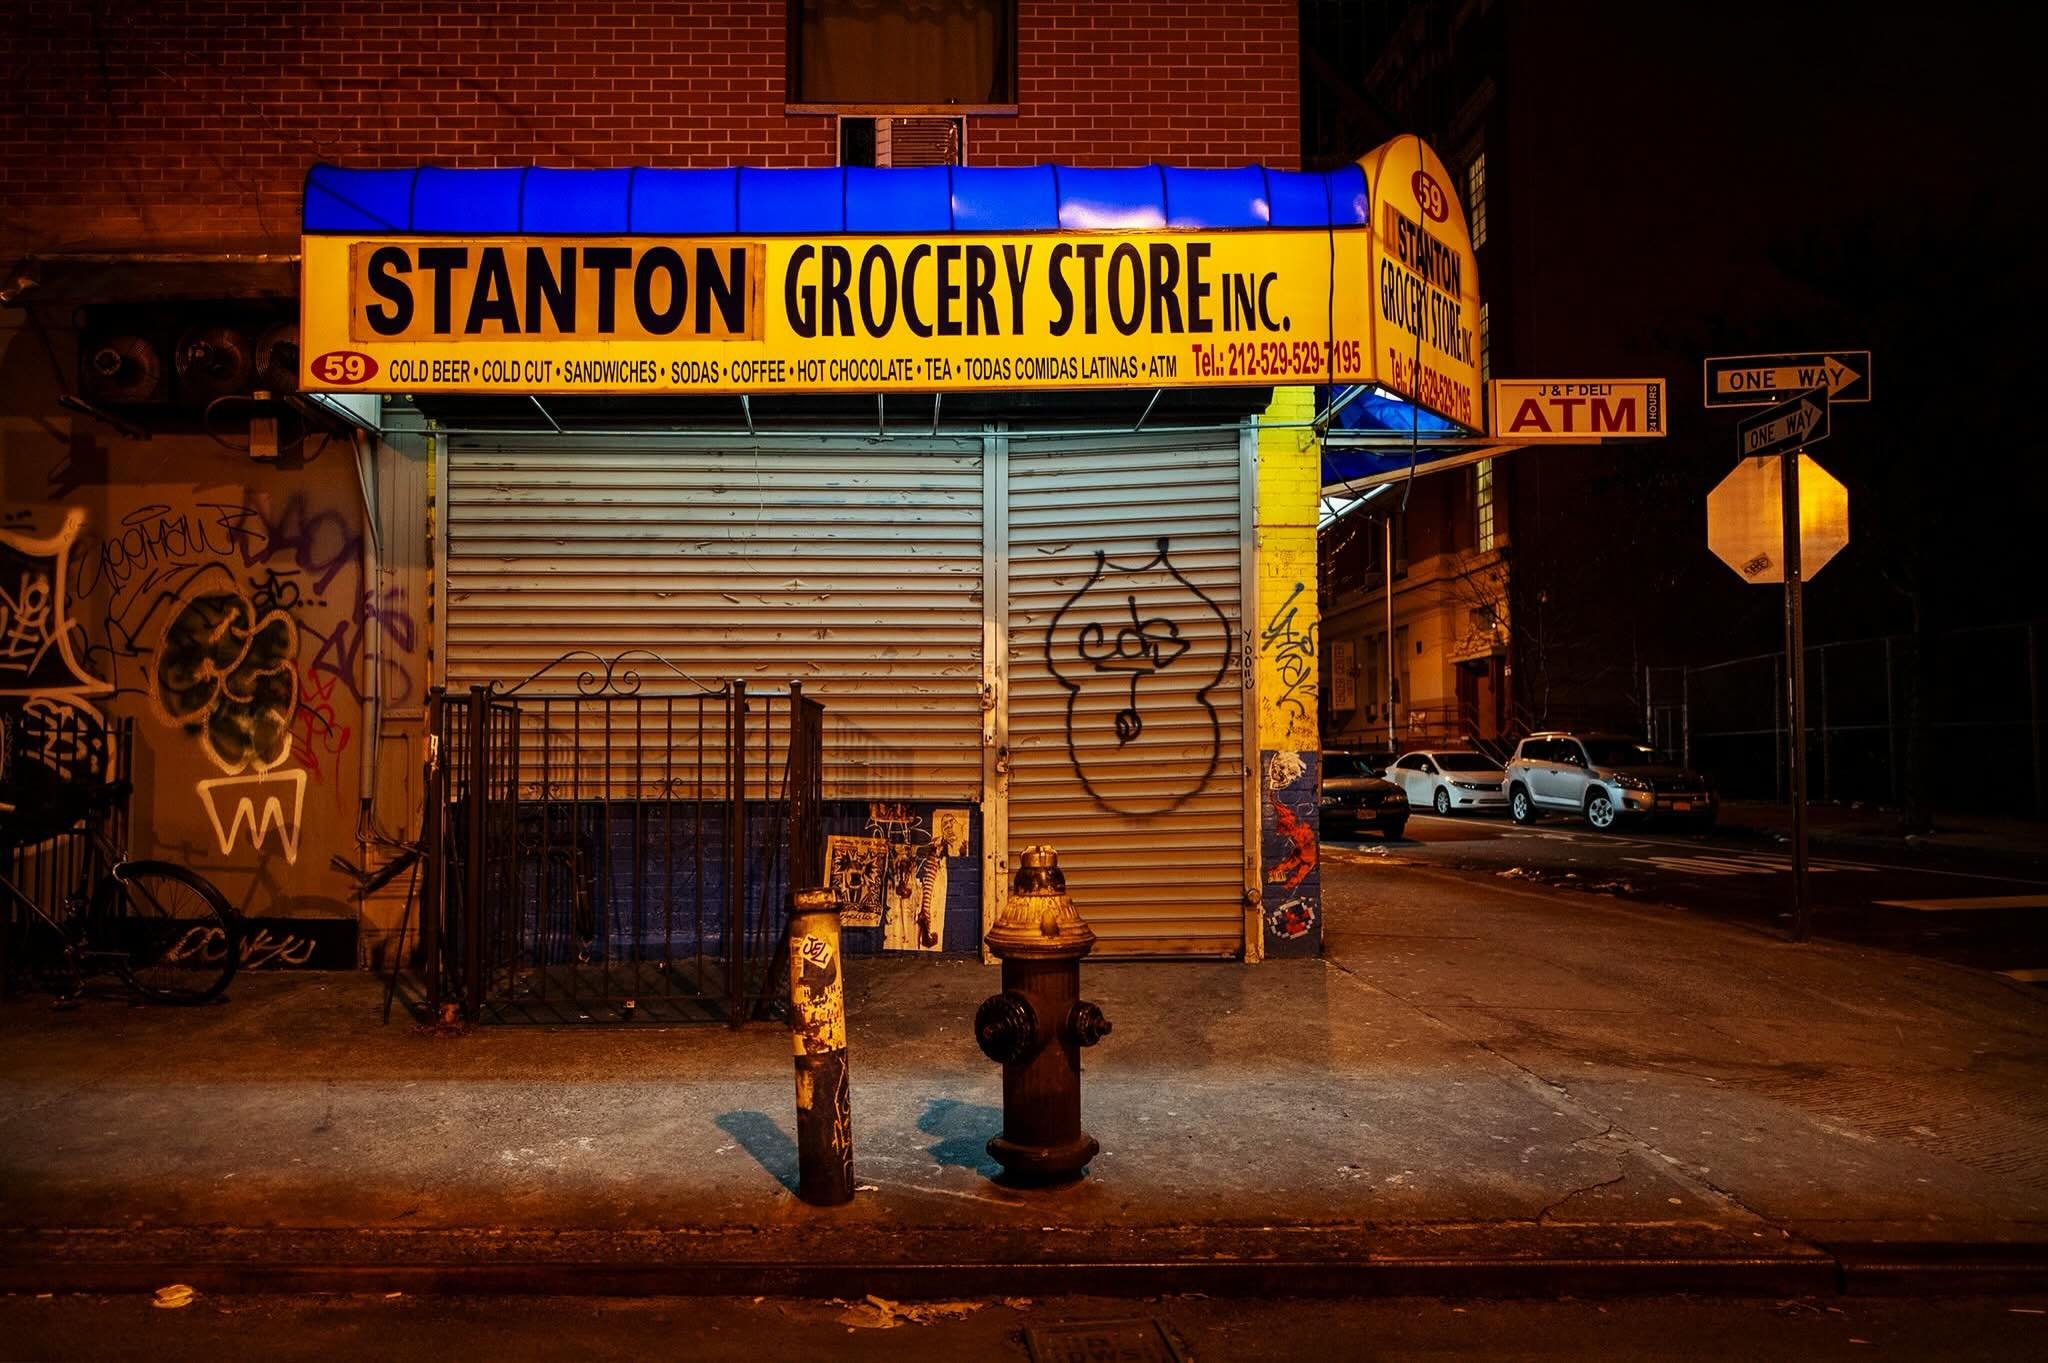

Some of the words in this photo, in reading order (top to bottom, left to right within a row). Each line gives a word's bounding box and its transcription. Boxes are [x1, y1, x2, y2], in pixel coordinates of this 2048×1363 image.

[1398, 215, 1460, 300] STANTON
[366, 246, 746, 336] STANTON
[784, 243, 1033, 338] GROCERY
[1048, 242, 1213, 337] STORE
[1222, 271, 1291, 332] INC.
[1381, 257, 1429, 343] GROCERY
[1431, 289, 1461, 363] STORE
[324, 355, 366, 381] 59
[390, 360, 429, 383] COLD
[433, 360, 470, 382] BEER
[482, 360, 521, 383] COLD
[525, 360, 552, 383] CUT
[564, 360, 657, 383] SANDWICHES
[671, 361, 719, 384] SODAS
[731, 360, 786, 383] COFFEE
[797, 359, 826, 382] HOT
[830, 358, 913, 382] CHOCOLATE
[925, 358, 952, 380] TEA
[965, 357, 1011, 380] TODAS
[1015, 355, 1078, 380] COMIDAS
[1081, 355, 1138, 379] LATINAS
[1149, 355, 1177, 378] ATM
[1192, 343, 1225, 377] Tel.:
[1538, 384, 1546, 396] J
[1551, 384, 1562, 396] &
[1566, 384, 1575, 396] F
[1579, 384, 1613, 396] DELI
[1730, 370, 1777, 390] ONE
[1798, 367, 1845, 386] WAY
[1509, 397, 1636, 433] ATM
[1649, 385, 1657, 420] HOURS
[1649, 421, 1657, 432] 24
[1750, 423, 1776, 449] ONE
[1786, 410, 1815, 433] WAY
